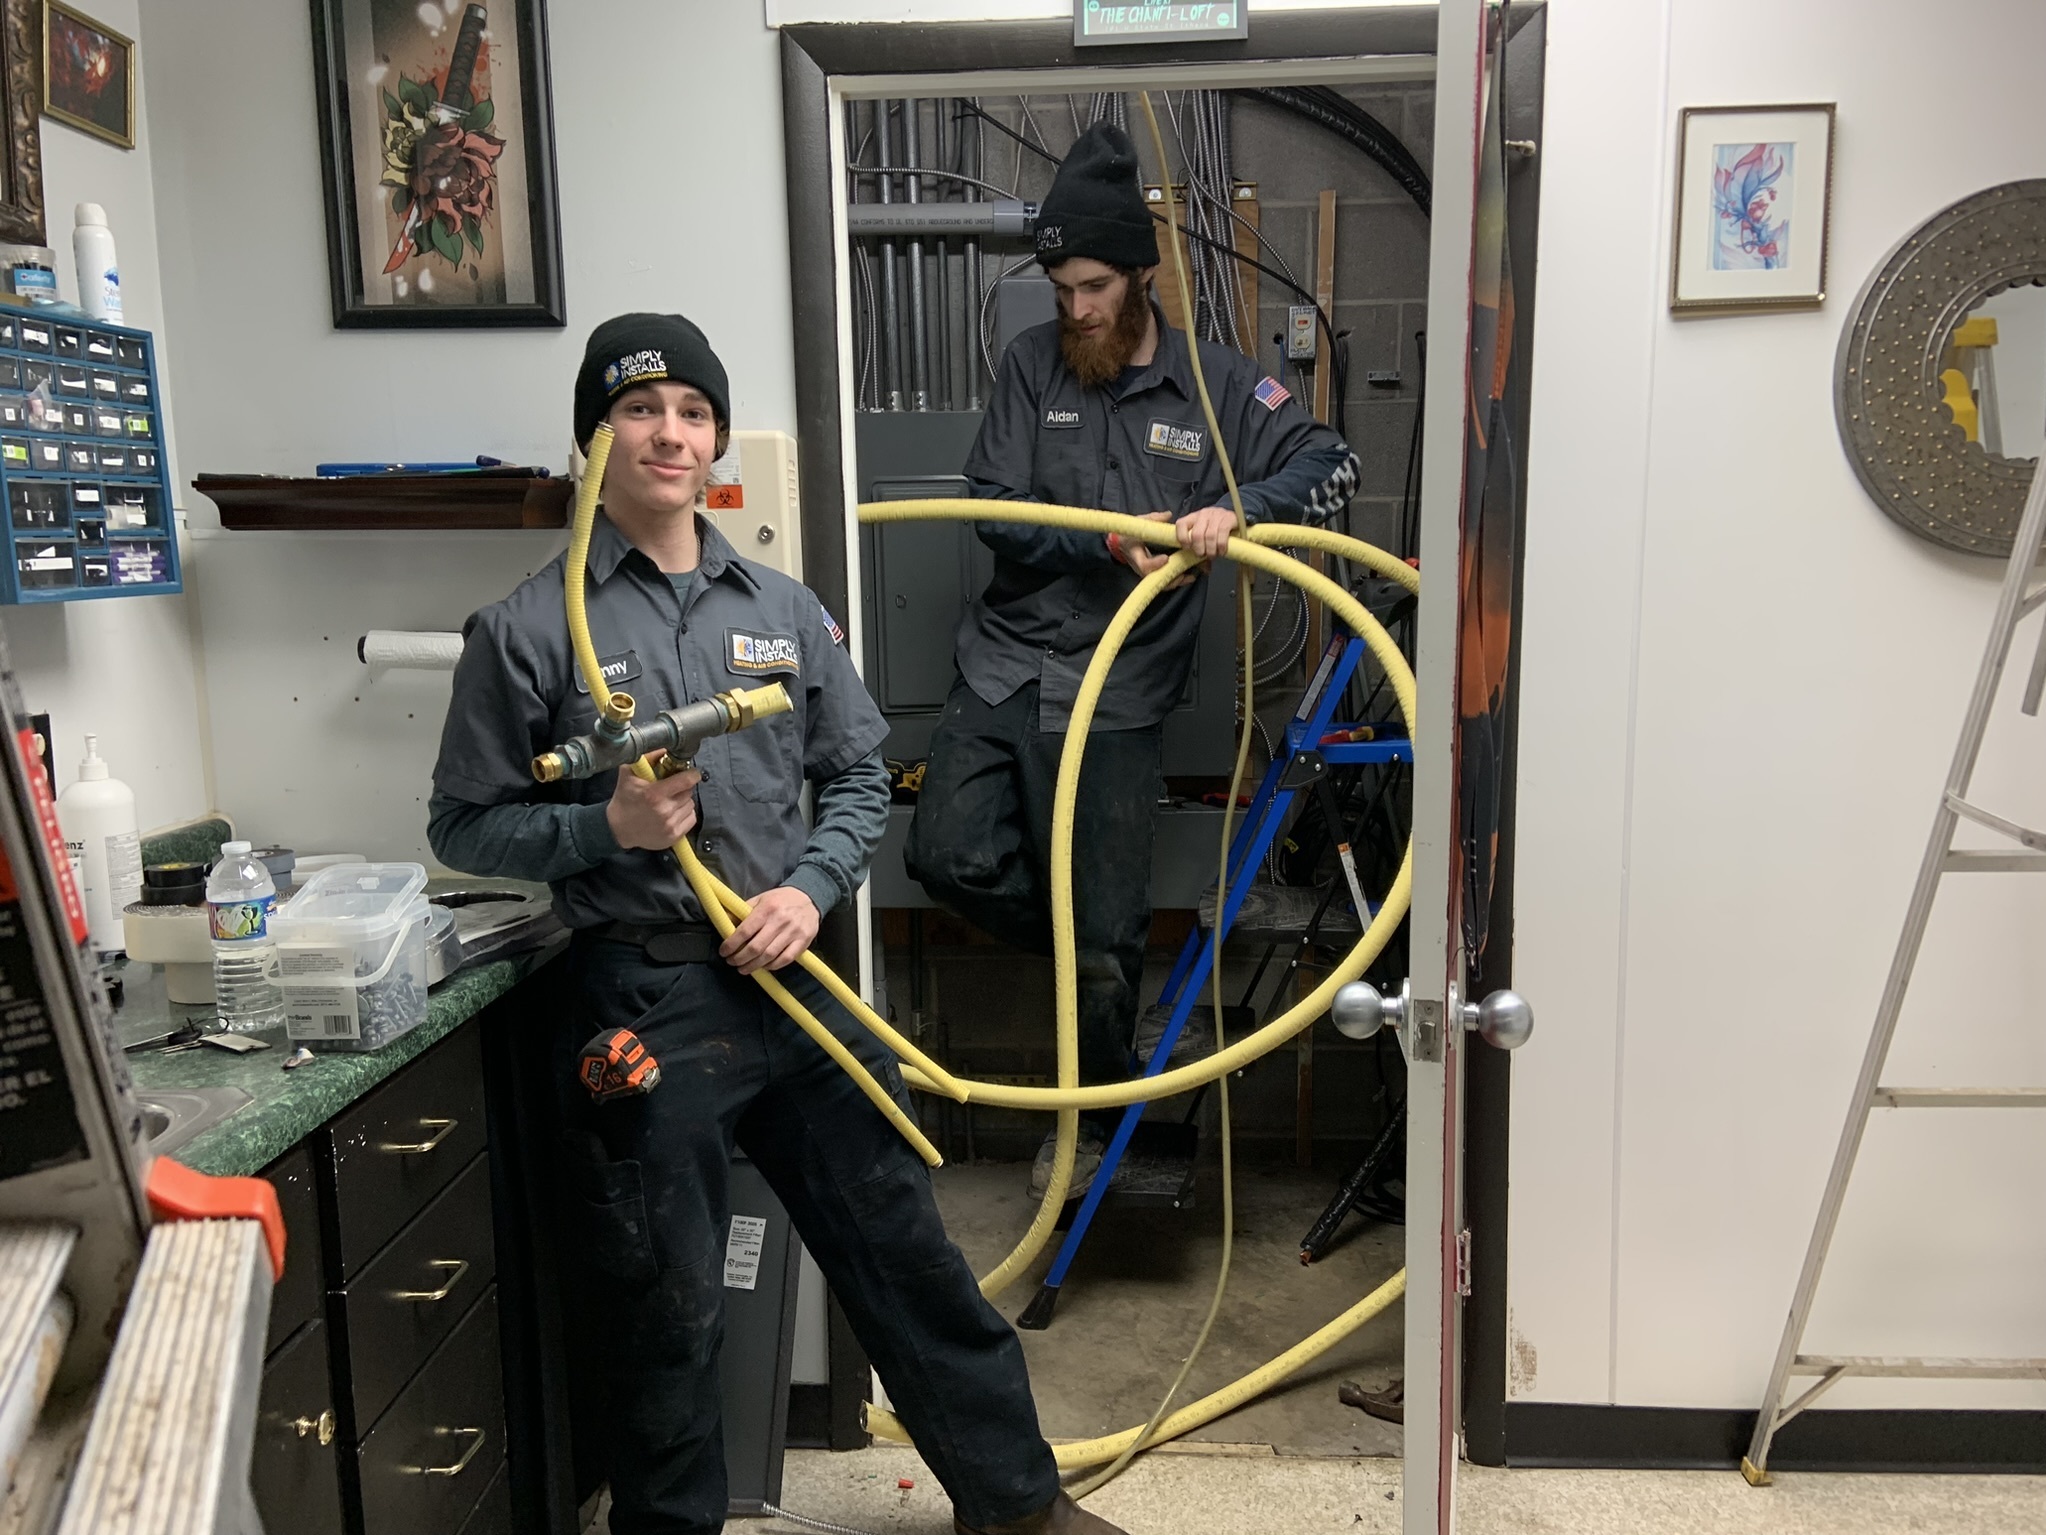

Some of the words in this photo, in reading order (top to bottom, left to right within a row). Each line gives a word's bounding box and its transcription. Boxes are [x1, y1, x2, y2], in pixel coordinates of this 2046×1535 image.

[1100, 7, 1125, 24] THE
[619, 350, 662, 369] SIMPLY
[620, 360, 667, 380] INSTALLS
[1046, 411, 1079, 423] Aidan
[1169, 427, 1202, 443] SIMPLY
[1167, 437, 1201, 452] INSTALLS
[755, 638, 796, 653] SIMPLY
[755, 650, 798, 664] INSTALLS
